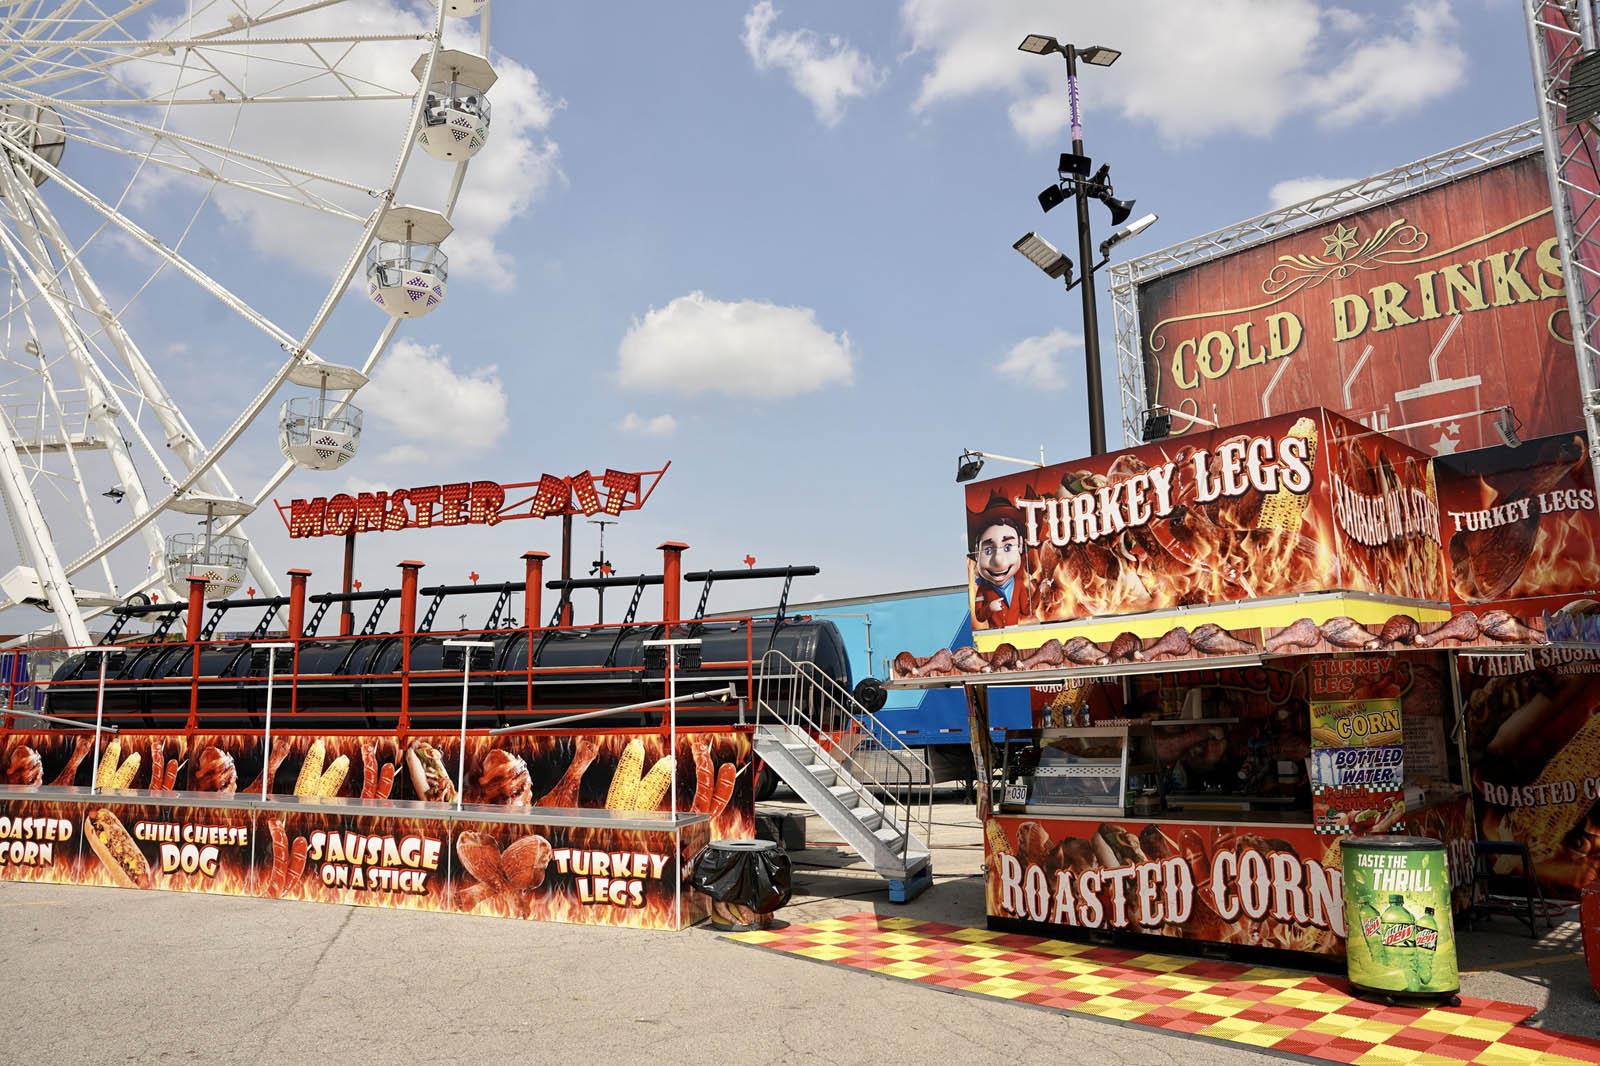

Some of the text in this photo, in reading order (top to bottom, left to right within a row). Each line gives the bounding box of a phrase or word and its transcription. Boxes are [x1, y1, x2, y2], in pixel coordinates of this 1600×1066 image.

[1171, 237, 1568, 389] COLD DRINKS
[290, 468, 642, 539] MONSTER PIT
[1016, 435, 1315, 548] TURKEY LEGS
[1335, 473, 1442, 548] SAUSAGE ON A STICK
[1448, 489, 1595, 532] TURKEY LEGS
[1312, 657, 1391, 675] TURKEY
[1314, 678, 1353, 693] LEG
[1337, 710, 1400, 739] CORN
[1335, 749, 1403, 768] BOTTLED
[1343, 768, 1394, 783] WATER
[1011, 787, 1025, 800] 030
[1325, 785, 1368, 799] Polish
[1481, 780, 1576, 807] ROASTED
[135, 821, 248, 846] CHILI CHEESE
[0, 841, 54, 866] CORN
[160, 842, 219, 877] DOG
[310, 830, 441, 870] SAUSAGE
[552, 848, 669, 879] TURKEY
[1358, 853, 1407, 868] TASTE THE
[321, 862, 427, 892] ON A STICK
[576, 877, 644, 906] LEGS
[1373, 869, 1432, 891] THRILL
[999, 849, 1345, 938] ROASTED CORN
